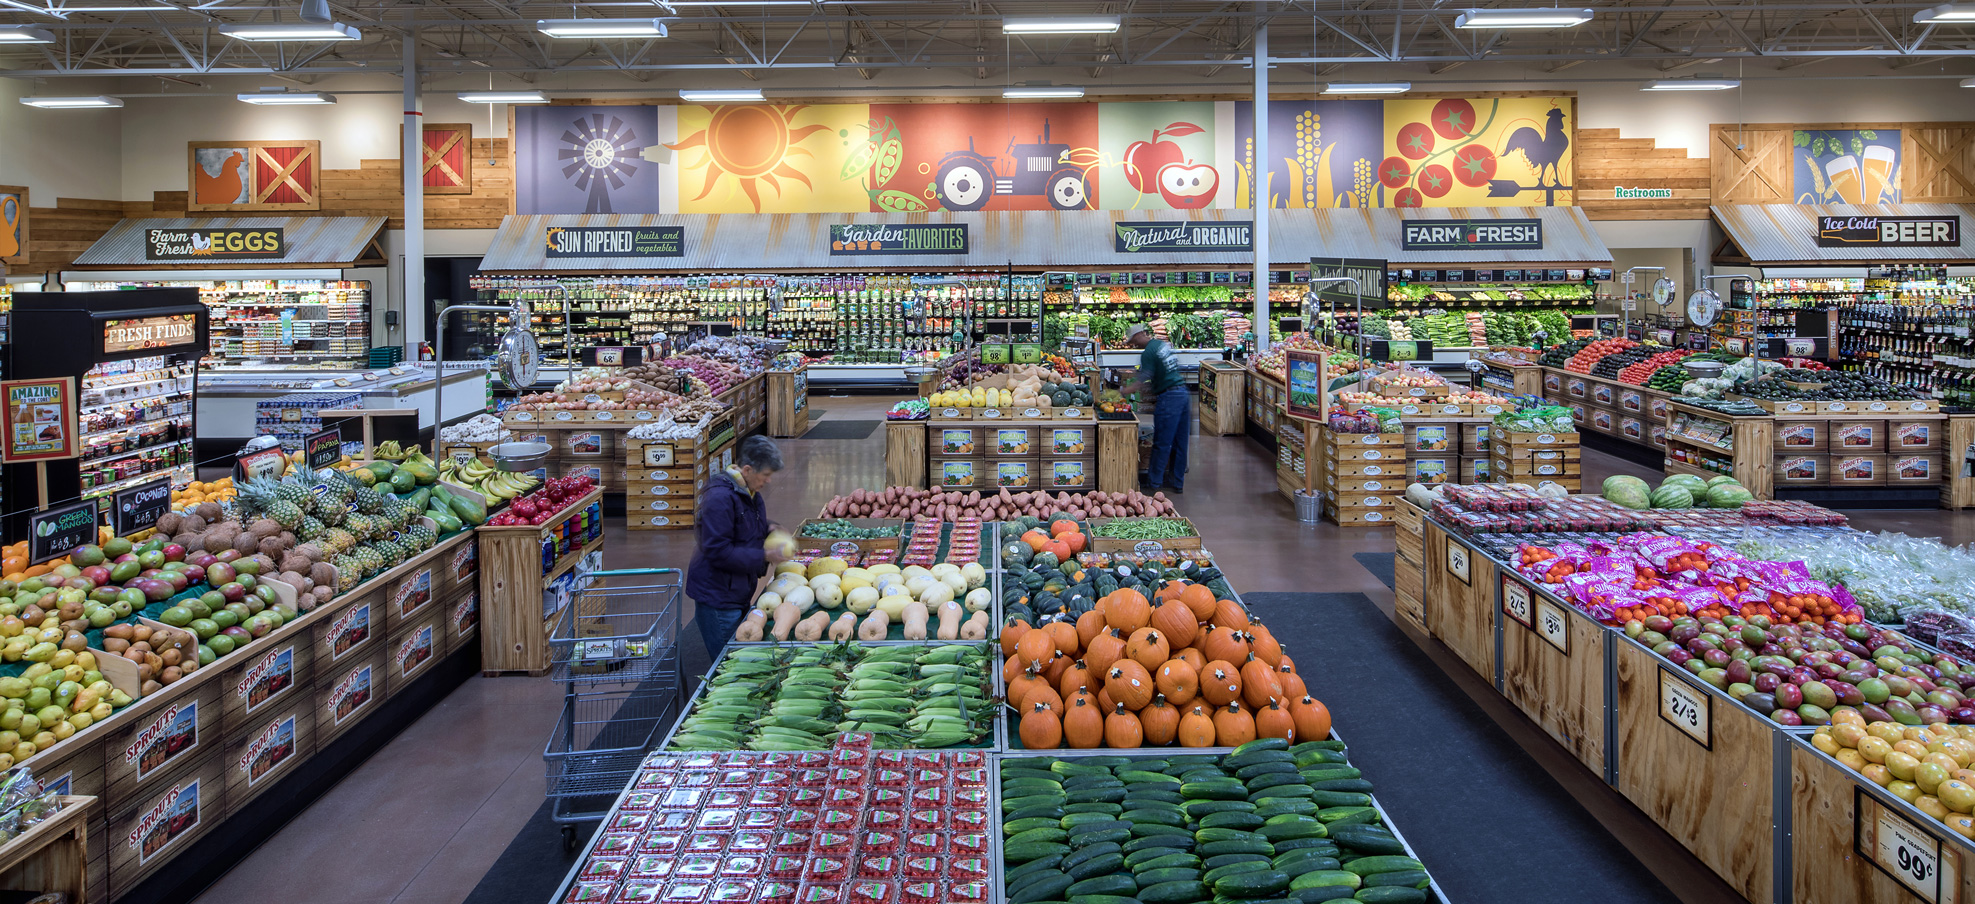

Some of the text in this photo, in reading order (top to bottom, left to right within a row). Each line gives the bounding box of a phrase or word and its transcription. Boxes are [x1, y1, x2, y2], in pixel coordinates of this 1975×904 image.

[1615, 187, 1671, 198] Restrooms
[1823, 216, 1878, 230] Ice Cold
[1881, 221, 1950, 242] BEER
[150, 230, 189, 243] Farm
[210, 231, 279, 251] EGGS
[557, 230, 632, 253] SUN RIPENED
[635, 230, 679, 242] fruits and
[841, 224, 904, 245] Garden
[903, 228, 964, 250] FAVORITES
[1123, 221, 1250, 248] Natural and ORGANIC
[1407, 226, 1538, 243] FARM FRESH
[155, 242, 194, 256] Fresh
[636, 243, 678, 254] vegetables
[1347, 268, 1382, 298] ORGANIC
[108, 323, 193, 343] FRESH FINDS
[11, 386, 59, 401] AMAZING
[135, 486, 168, 504] COCONUTS
[55, 514, 94, 532] MANGOS
[58, 508, 88, 524] GREEN
[327, 605, 358, 643] SPROUTS
[397, 626, 422, 662] SPROUTS
[586, 646, 613, 655] SPROUTS
[238, 649, 278, 694] SPROUTS
[329, 667, 359, 709] SPROUTS
[127, 705, 177, 761] SPROUTS
[240, 720, 279, 769] SPROUTS
[130, 785, 180, 846] SPROUTS
[1895, 831, 1906, 843] PINK
[1907, 839, 1936, 862] GRAPEFRUIT
[1898, 845, 1933, 881] 99¢
